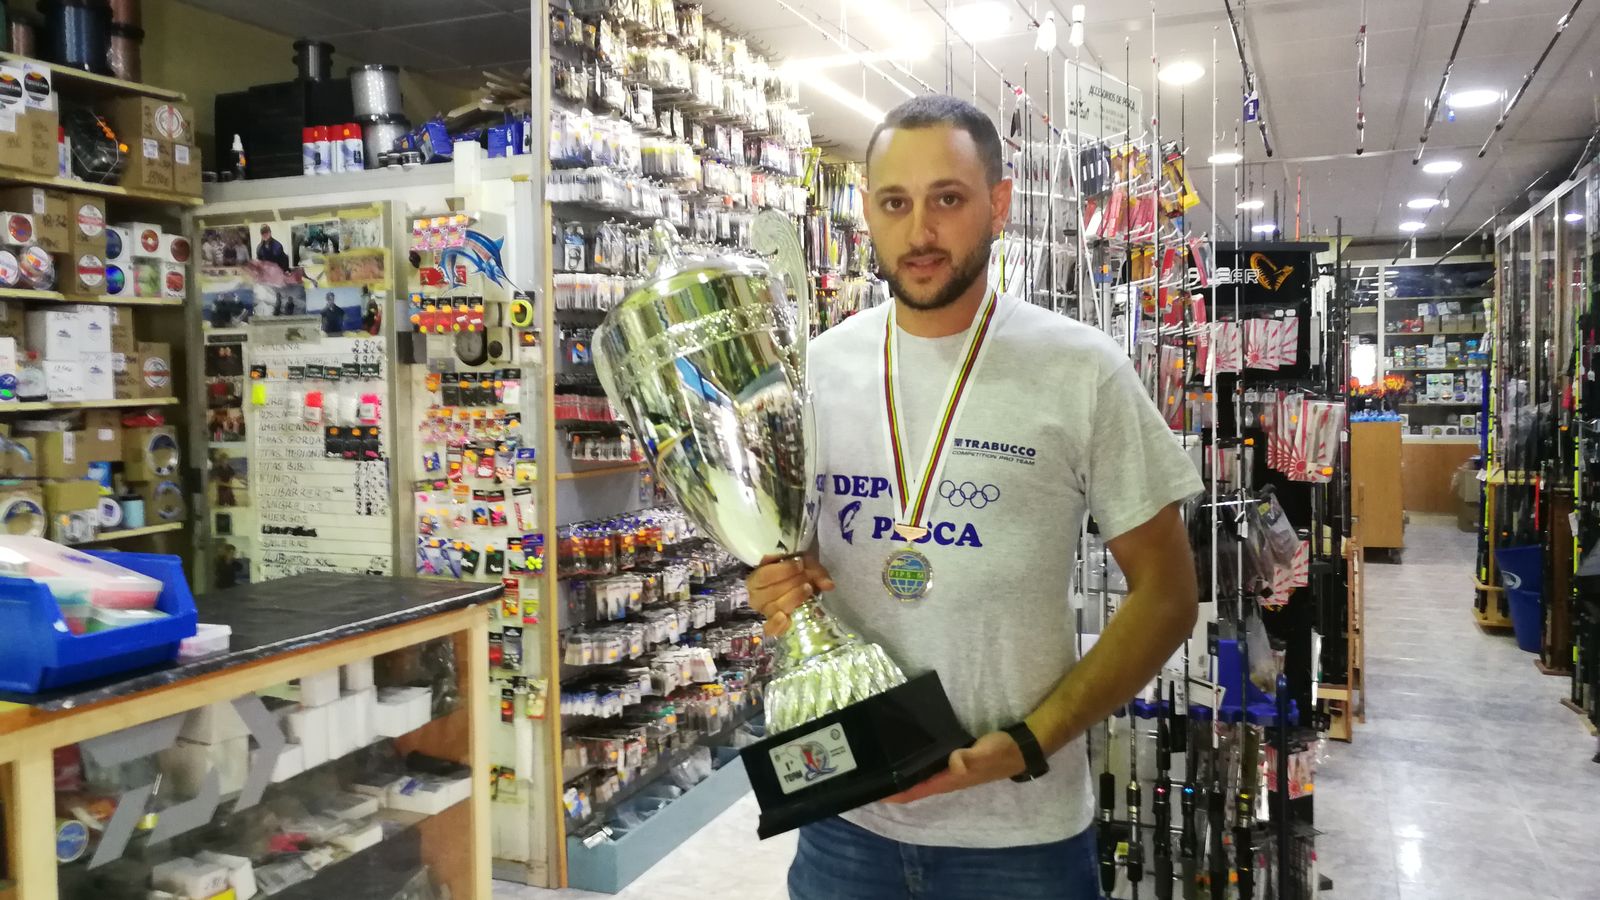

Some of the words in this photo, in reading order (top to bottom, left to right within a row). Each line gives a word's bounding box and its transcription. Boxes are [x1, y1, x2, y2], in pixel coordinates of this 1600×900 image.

[952, 450, 997, 460] COMPETITION
[965, 439, 1036, 457] TRABUCCO
[832, 474, 894, 499] DEP
